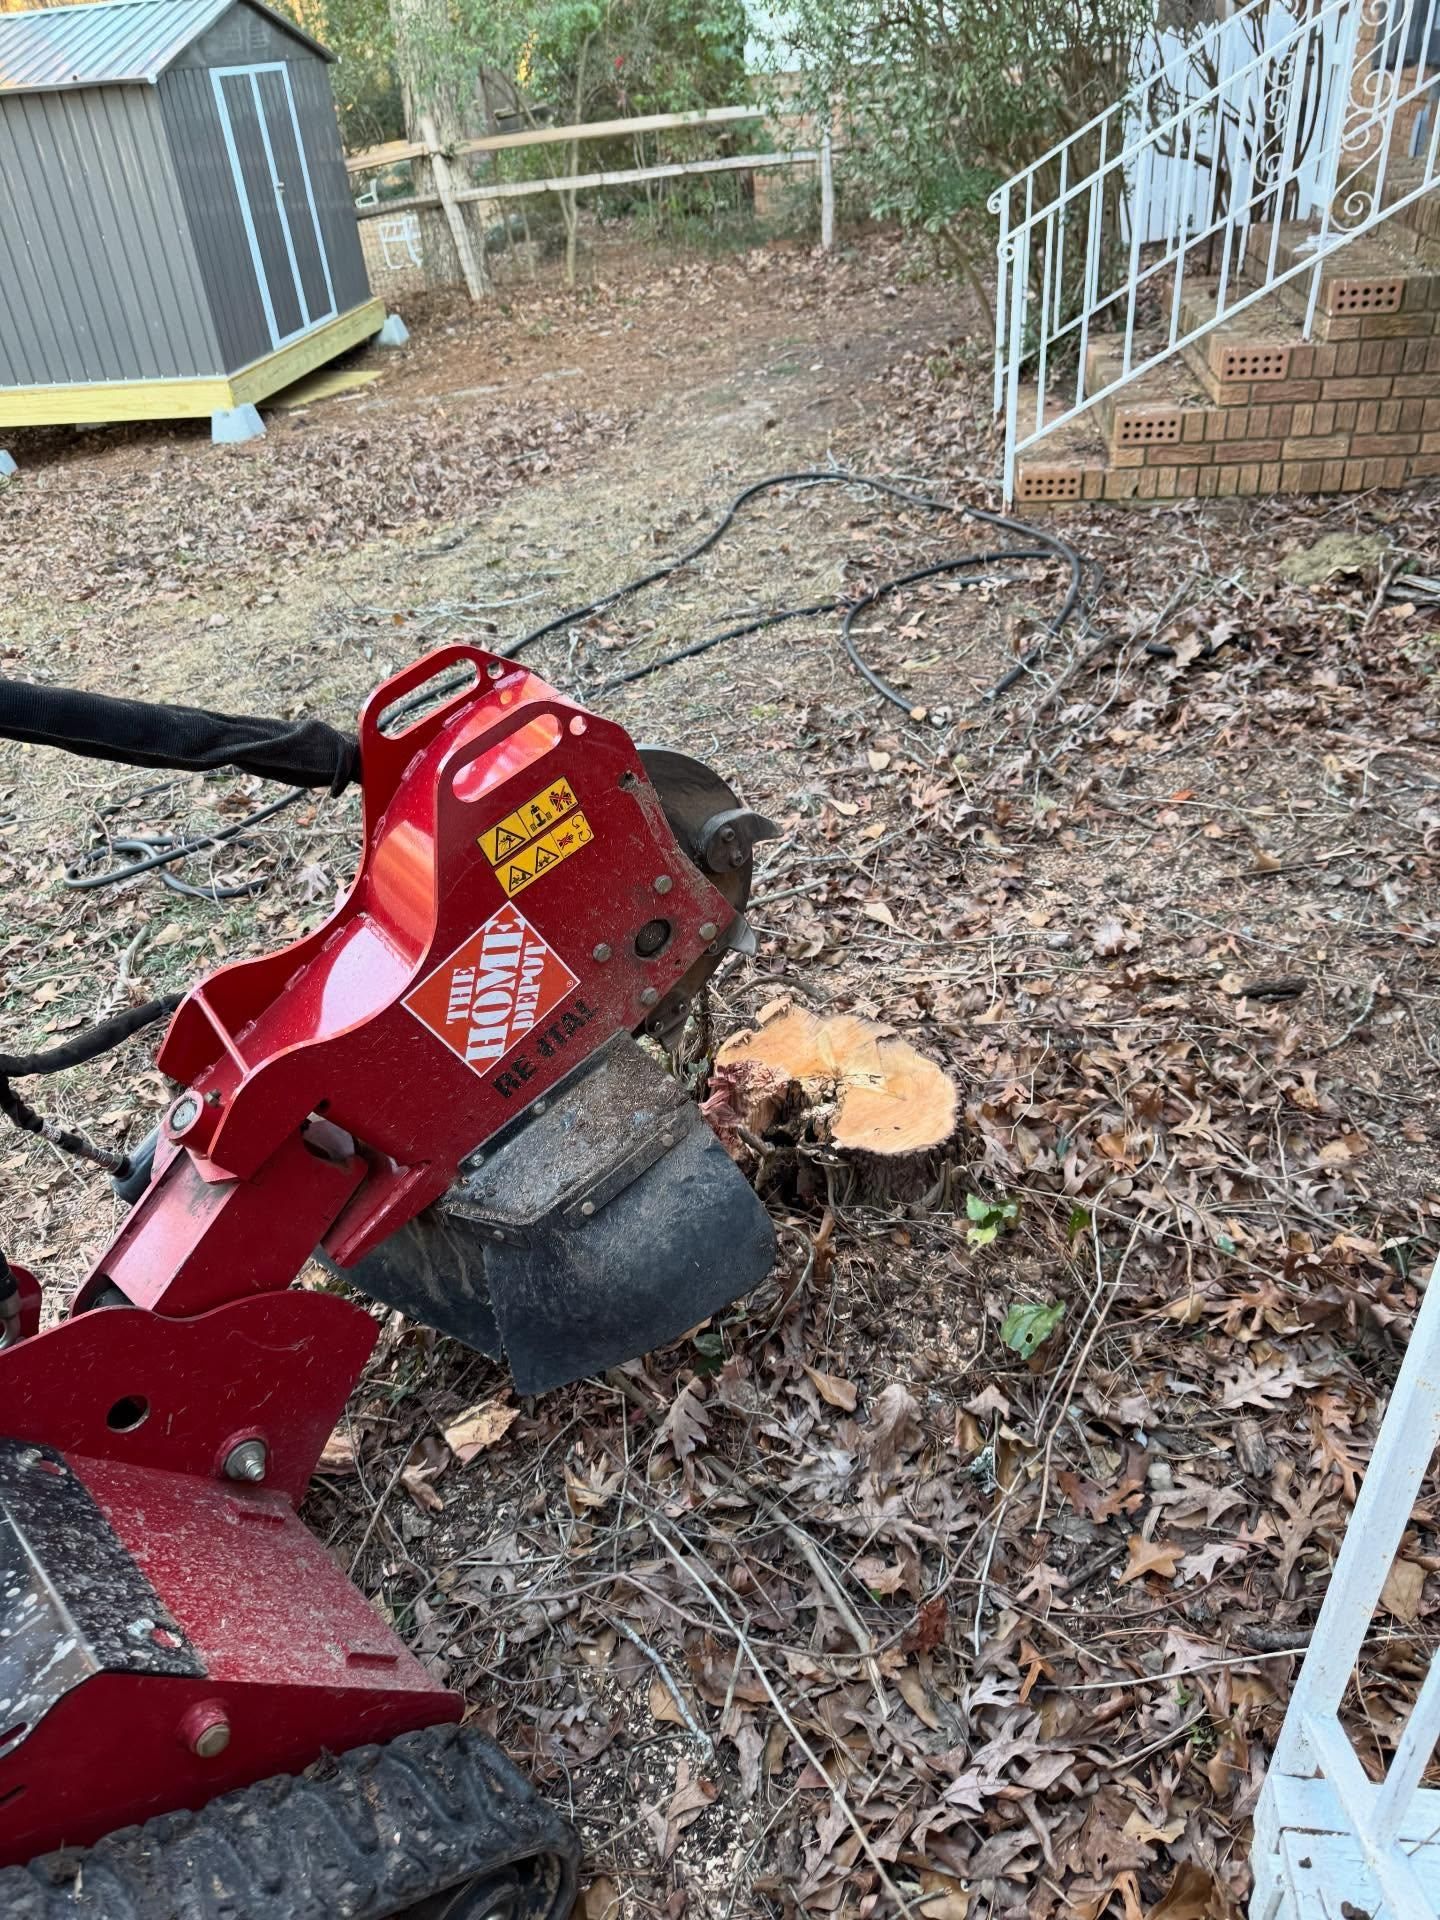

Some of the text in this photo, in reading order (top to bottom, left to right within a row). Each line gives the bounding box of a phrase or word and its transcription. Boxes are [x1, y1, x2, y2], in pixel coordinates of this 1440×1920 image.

[446, 966, 475, 1025] THE
[465, 918, 526, 1062] HOME
[512, 941, 548, 1032] DEPOT
